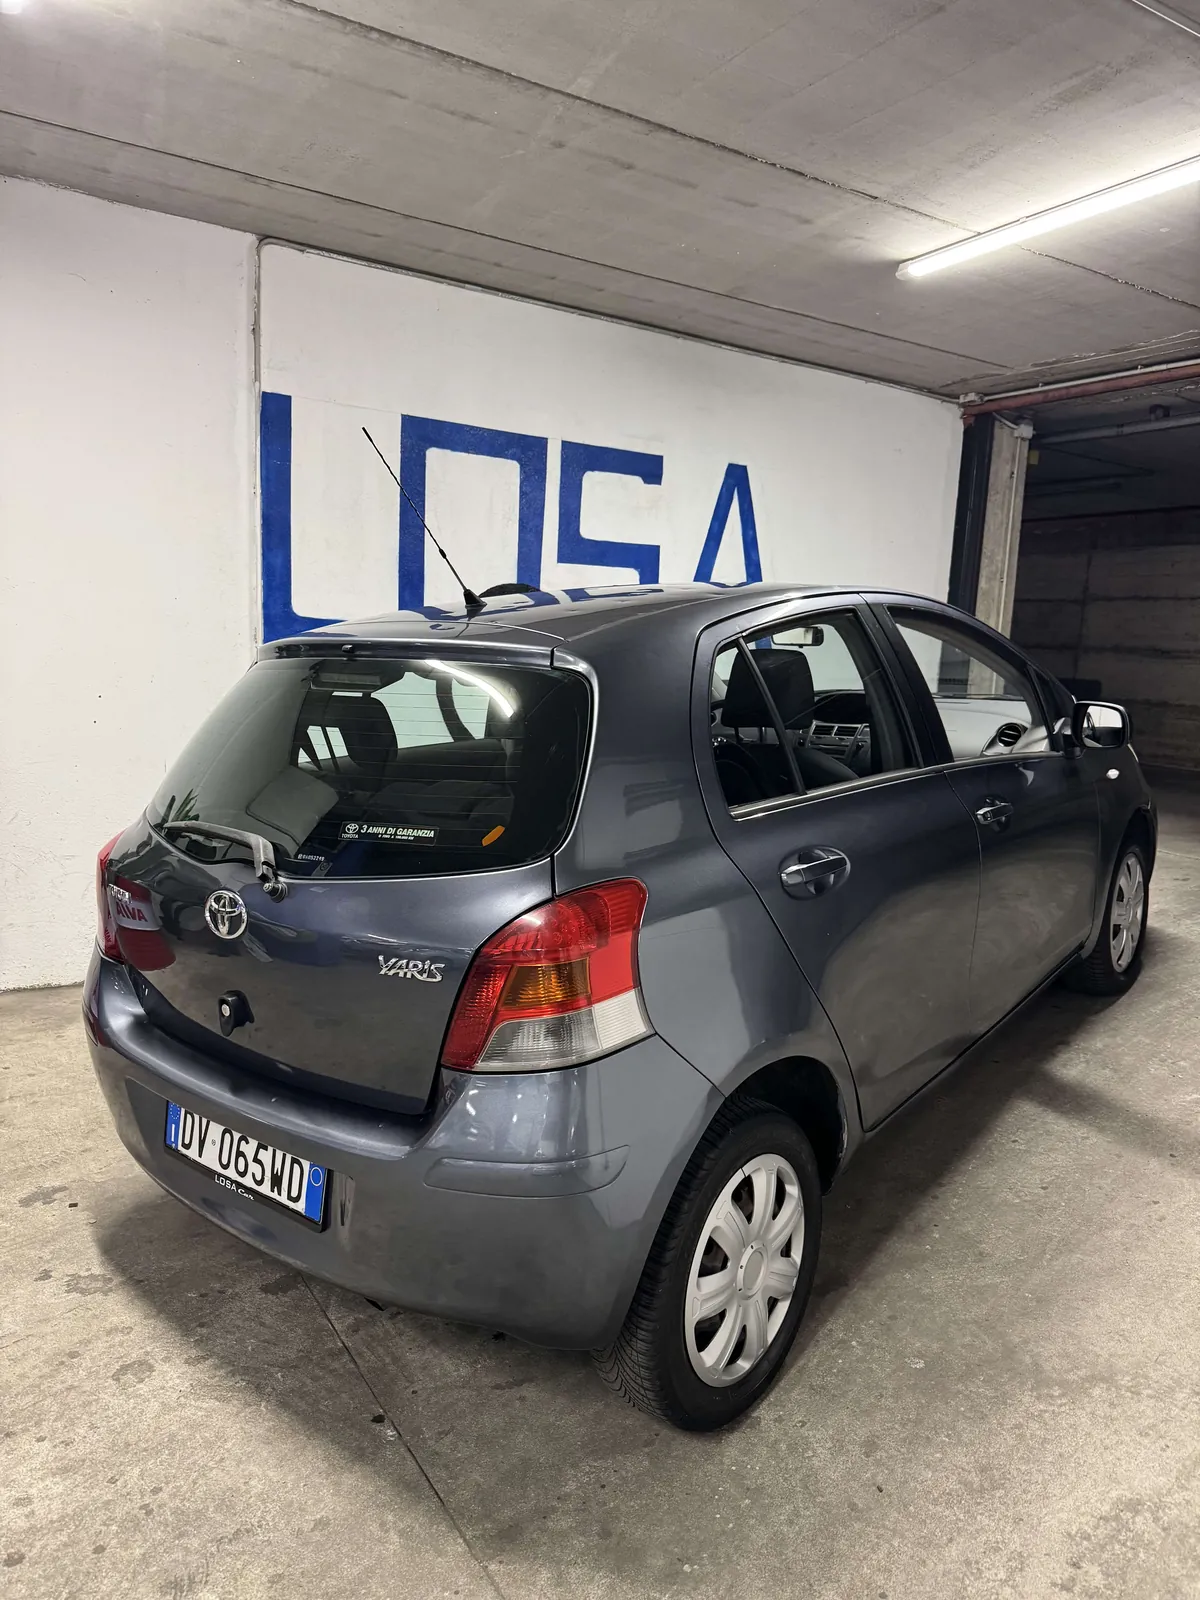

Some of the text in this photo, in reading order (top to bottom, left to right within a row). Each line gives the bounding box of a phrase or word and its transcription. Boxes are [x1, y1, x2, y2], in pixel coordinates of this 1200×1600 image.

[261, 391, 762, 643] LOSA
[360, 824, 435, 838] 3 ANNI DI GARANZIA
[378, 955, 446, 982] YARIS
[181, 1109, 304, 1204] DV 065WD
[215, 1174, 237, 1193] LOSA
